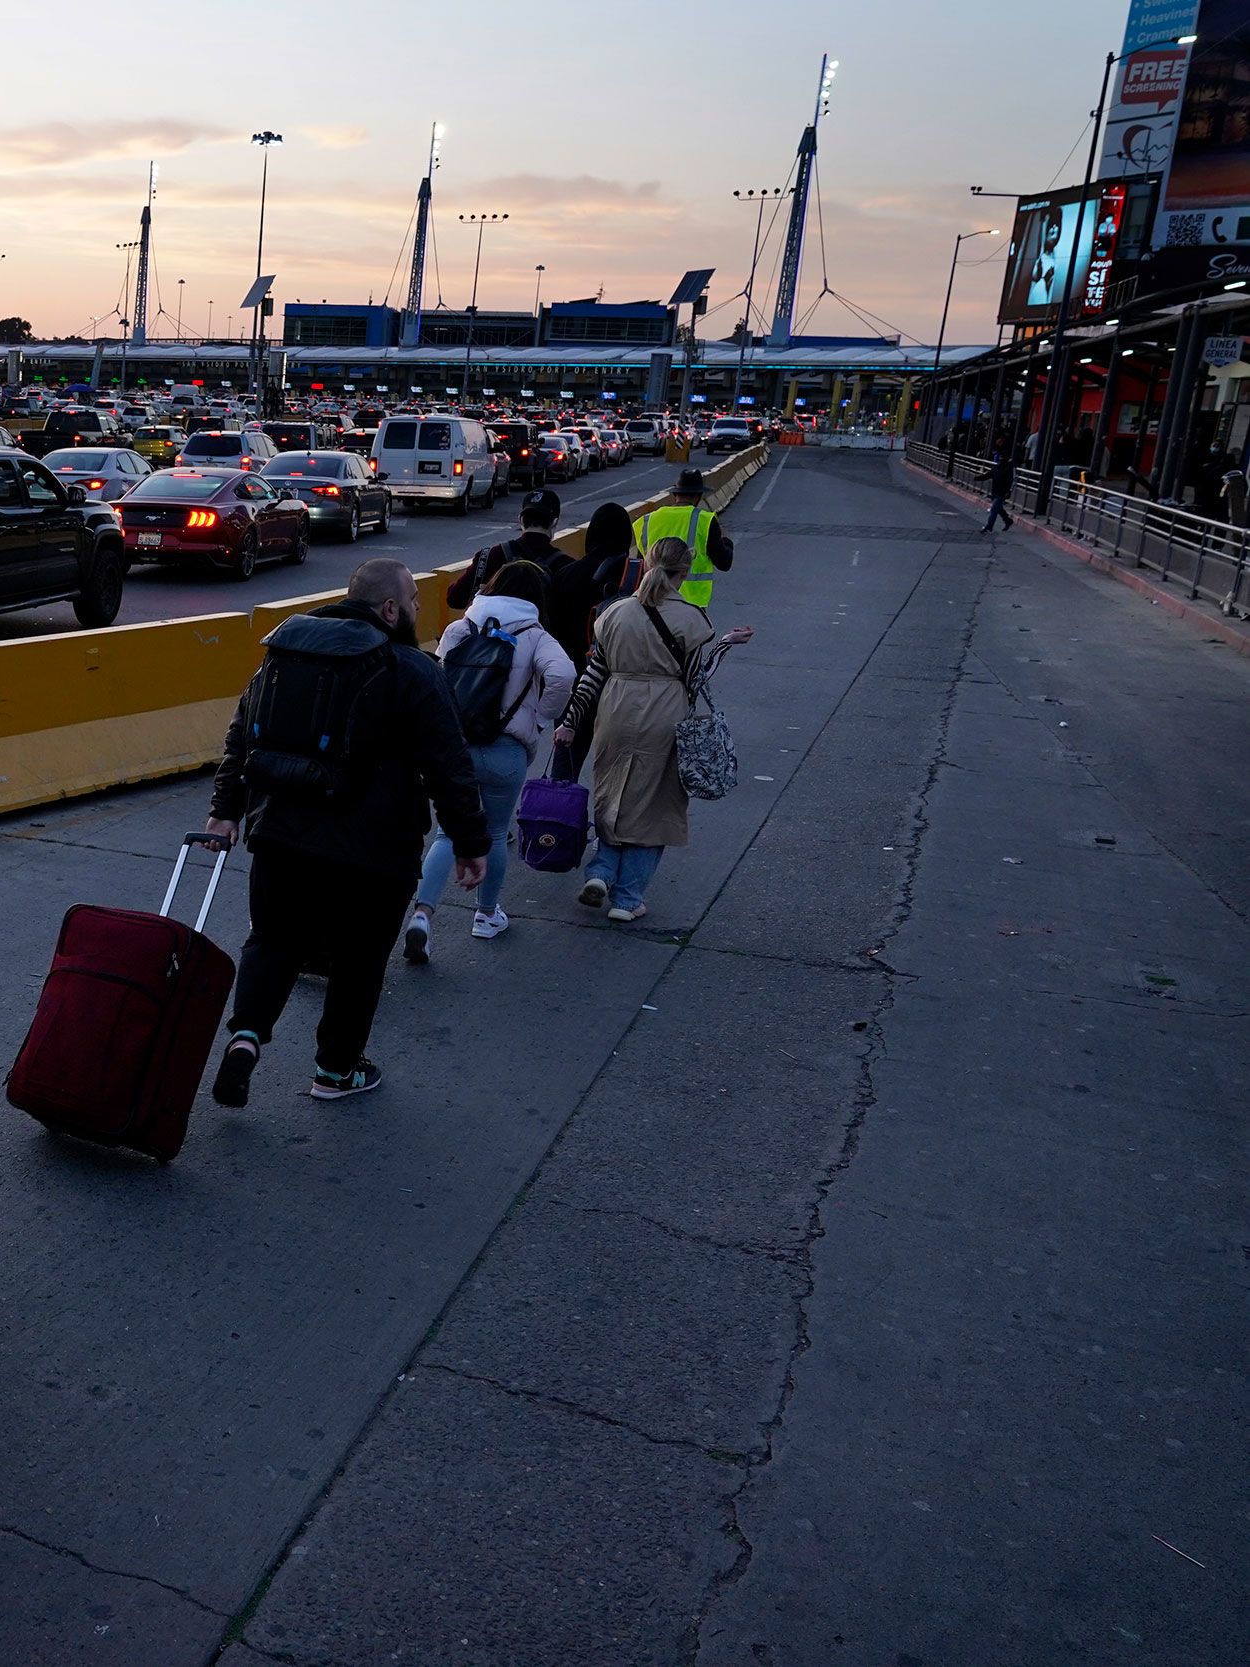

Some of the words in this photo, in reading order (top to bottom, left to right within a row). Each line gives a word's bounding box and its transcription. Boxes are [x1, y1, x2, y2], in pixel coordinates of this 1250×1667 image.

[1128, 59, 1189, 82] FREE
[1123, 81, 1181, 94] SCREENING
[1205, 350, 1238, 359] GENERAL
[495, 366, 533, 374] YSIDRO
[540, 366, 567, 374] PORT
[574, 367, 587, 375] OF
[594, 367, 631, 375] ENTRY
